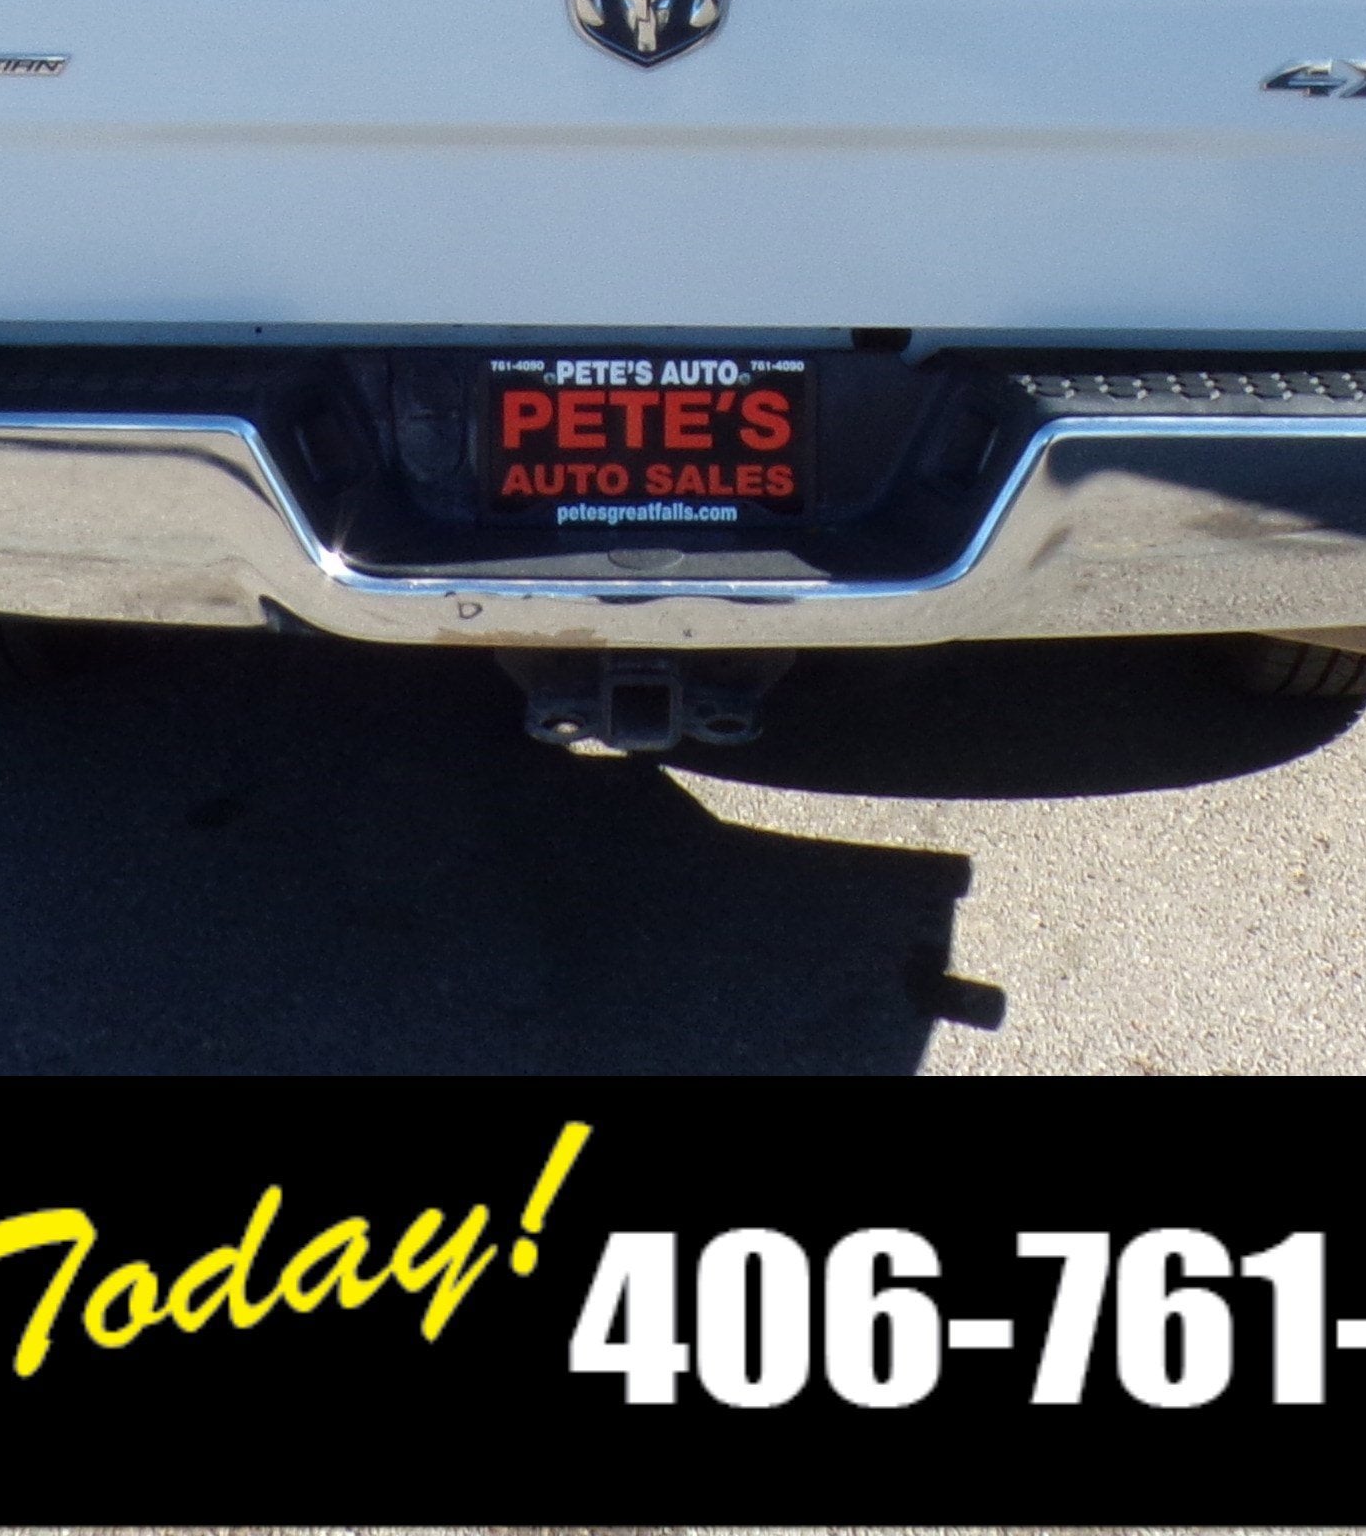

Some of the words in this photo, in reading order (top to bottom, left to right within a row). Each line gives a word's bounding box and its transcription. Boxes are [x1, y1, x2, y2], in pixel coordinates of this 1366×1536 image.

[556, 360, 653, 386] PETE'S
[660, 360, 739, 386] AUTO
[502, 390, 792, 451] PETE'S
[501, 464, 629, 496] AUTO
[645, 464, 795, 497] SALES
[556, 502, 738, 525] petesgreatfalls.com
